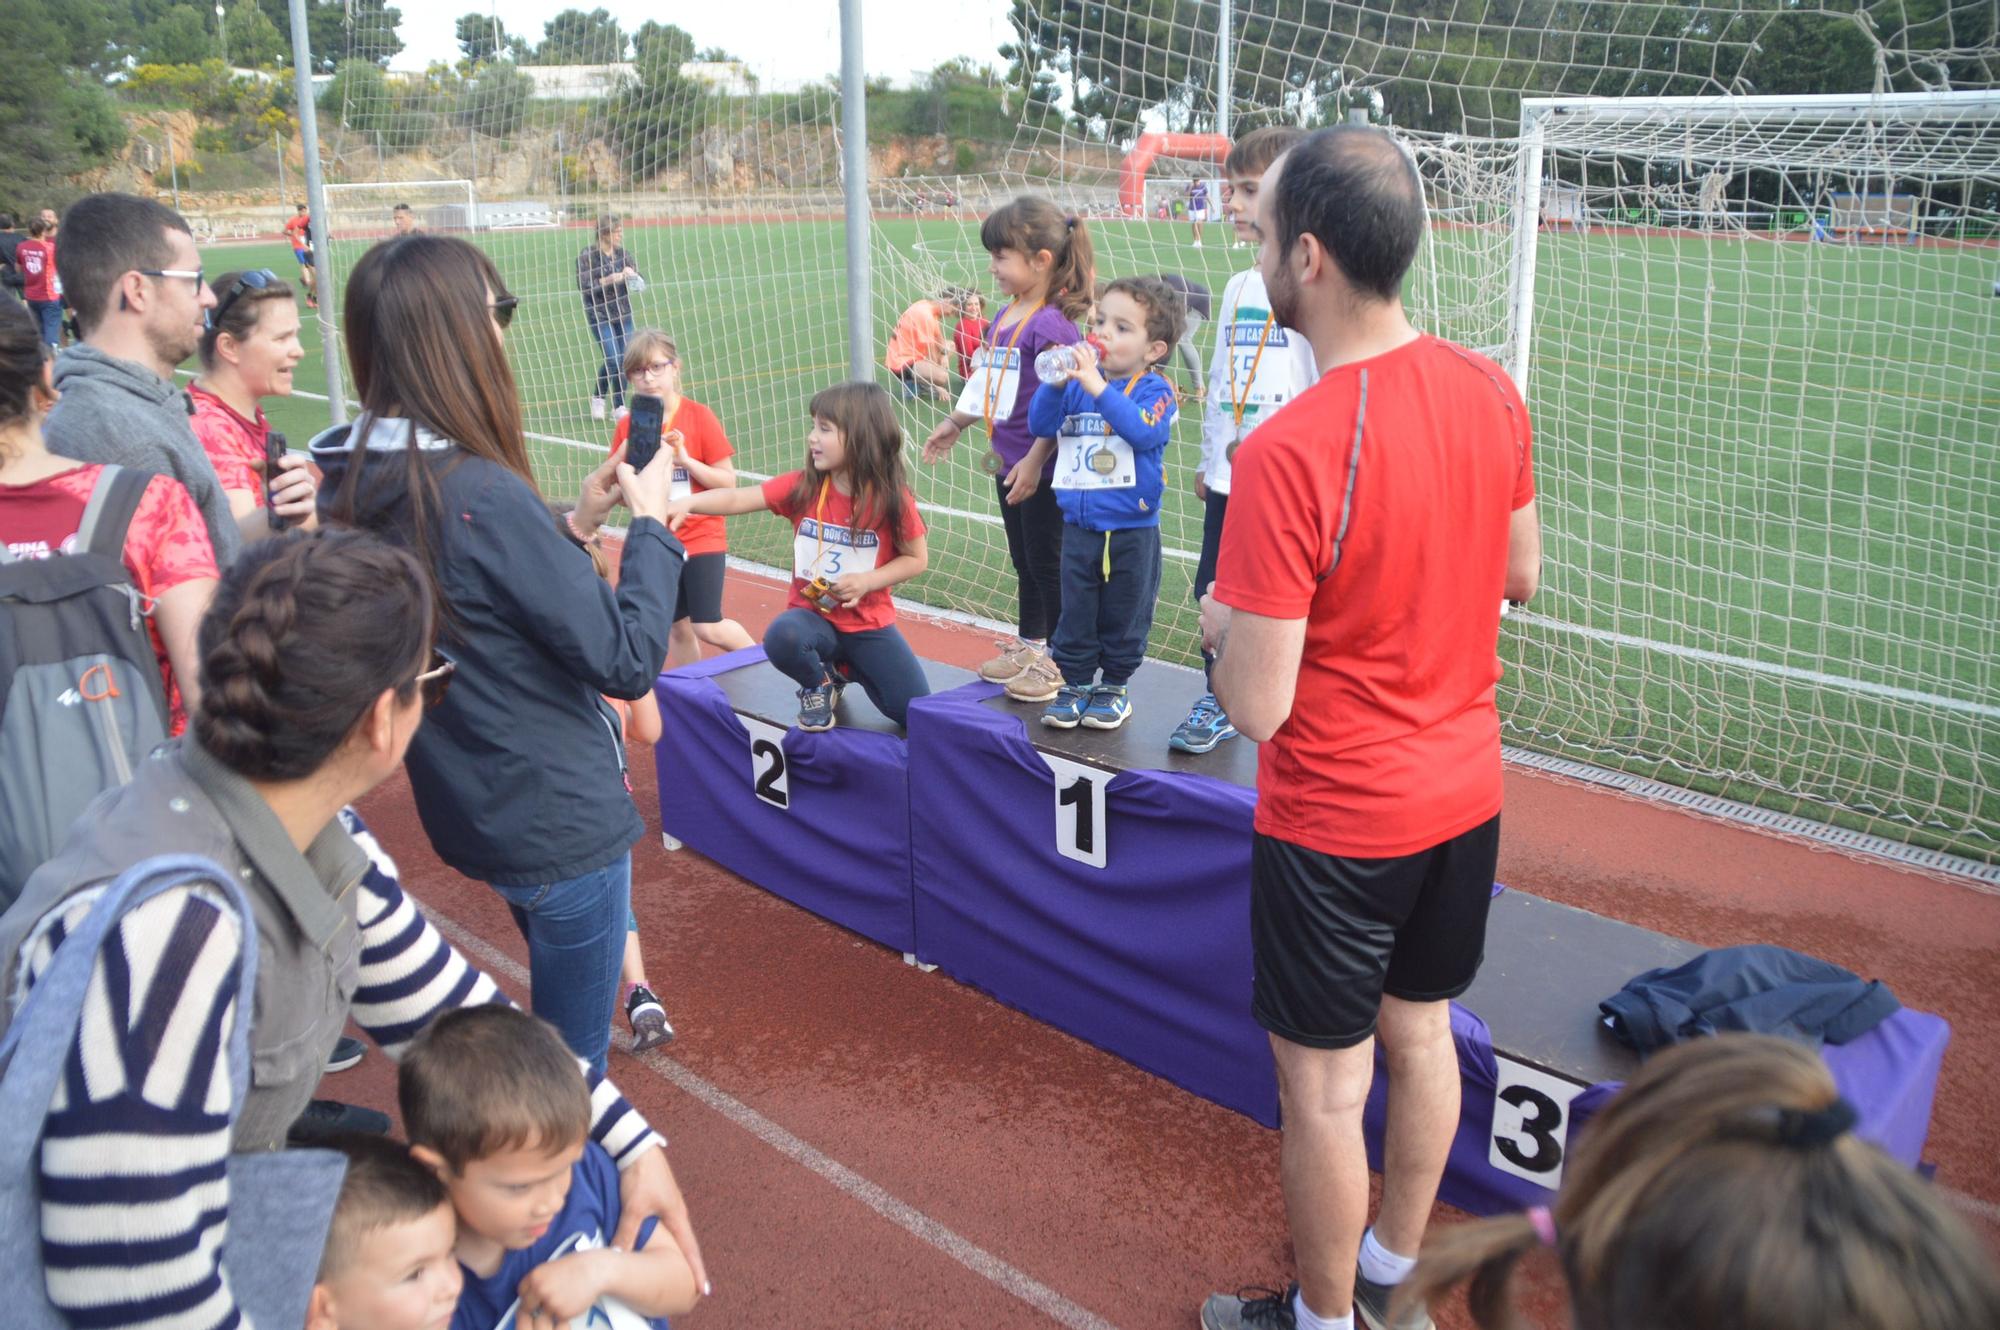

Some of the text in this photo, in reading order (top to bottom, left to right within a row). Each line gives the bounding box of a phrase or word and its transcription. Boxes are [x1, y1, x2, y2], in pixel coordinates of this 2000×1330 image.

[1246, 327, 1285, 343] CASELL
[825, 551, 842, 574] 3
[753, 739, 787, 806] 2
[1060, 776, 1093, 854] 1
[1494, 1084, 1562, 1173] 3
